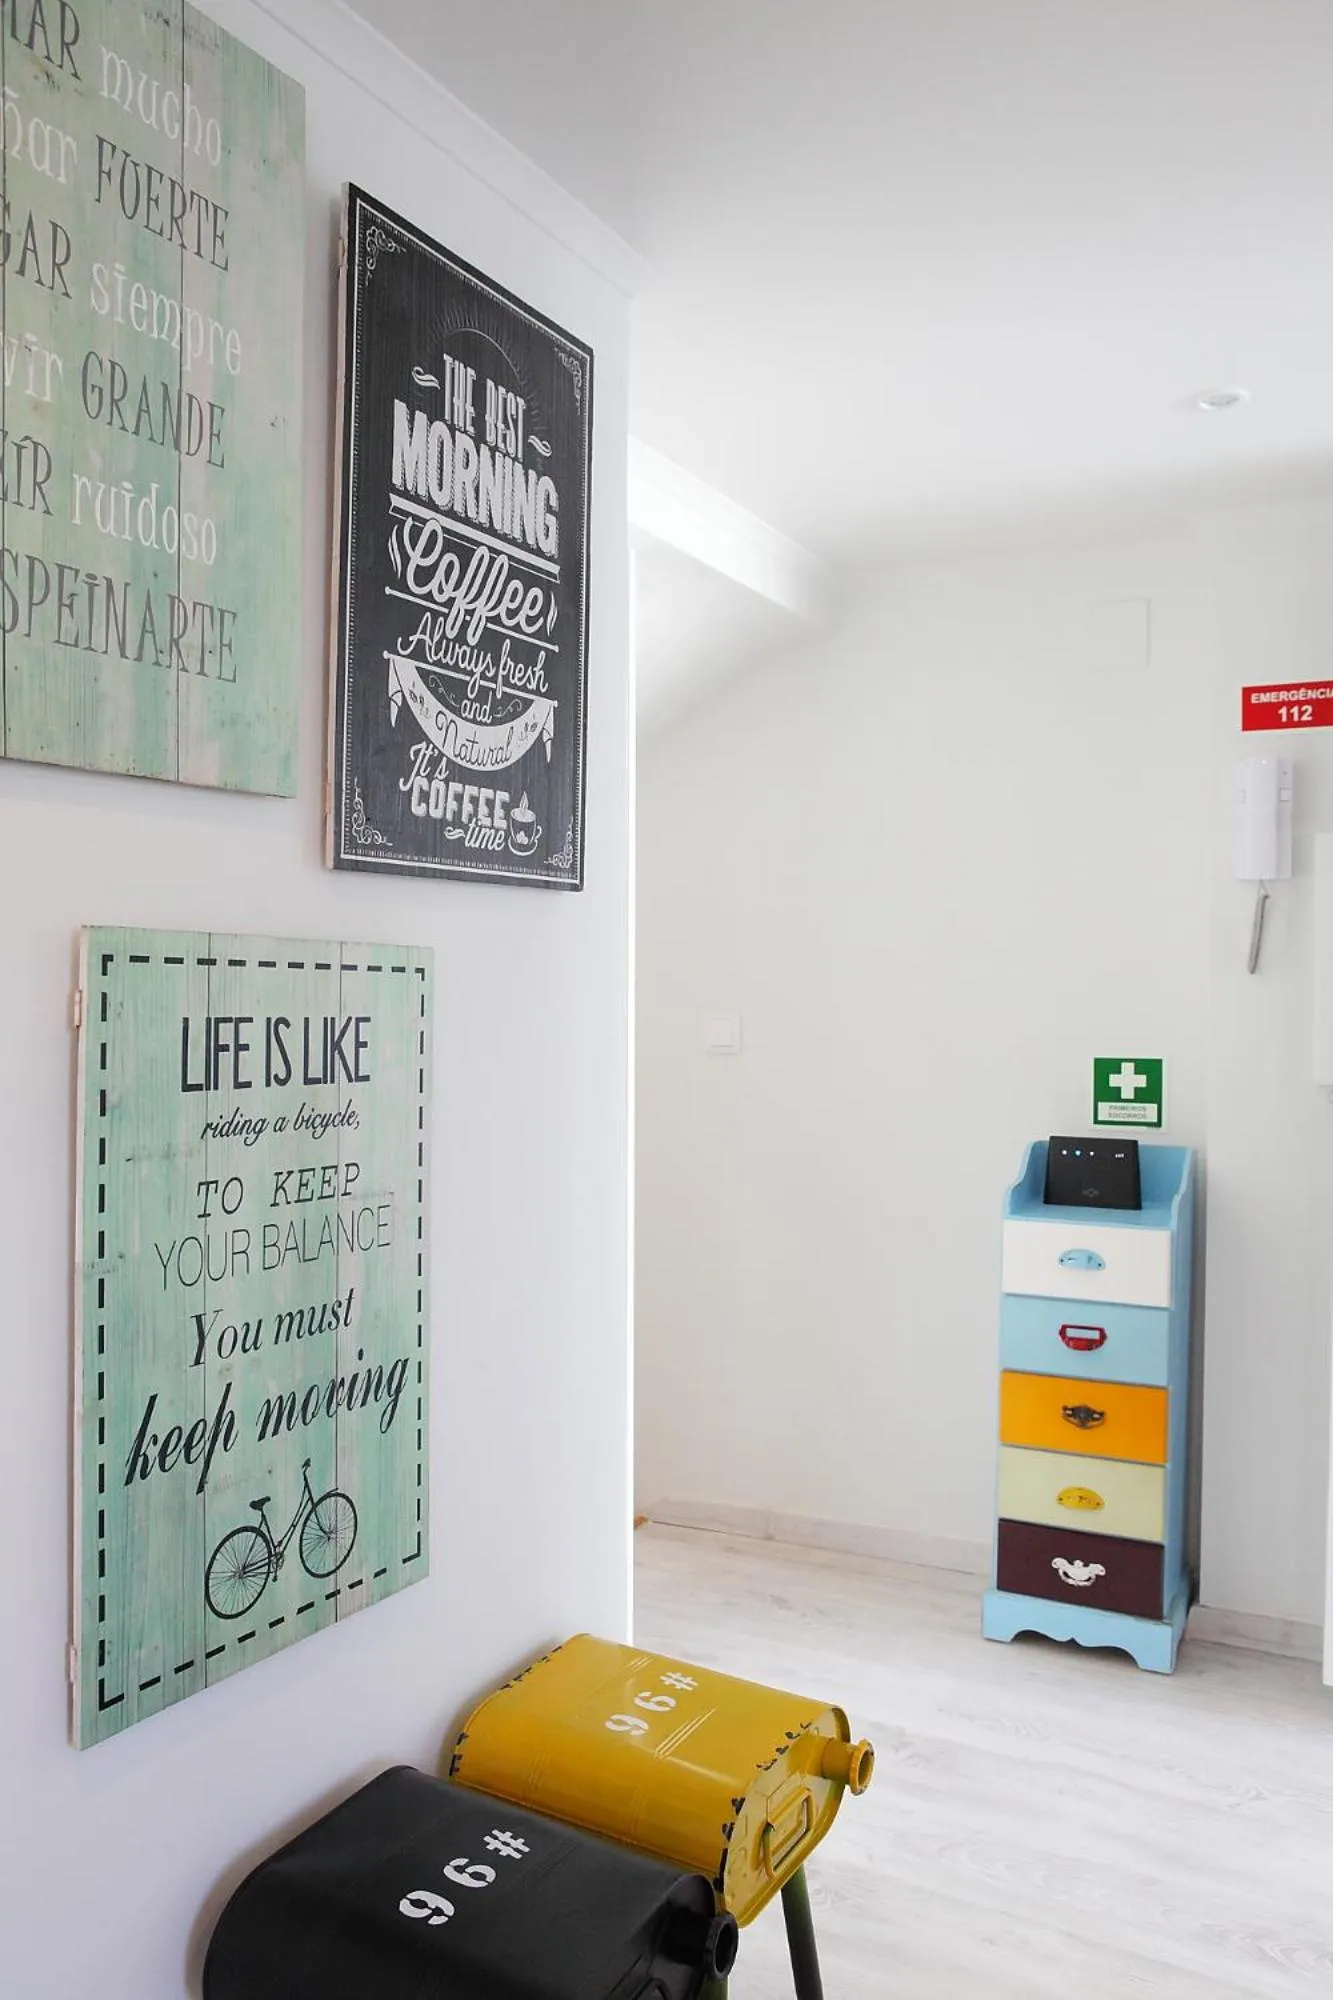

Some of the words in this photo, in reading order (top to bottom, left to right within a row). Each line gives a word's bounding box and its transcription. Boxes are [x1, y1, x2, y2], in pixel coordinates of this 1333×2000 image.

[11, 0, 82, 81] AR
[99, 46, 222, 167] mucho
[95, 134, 230, 272] FUERTE
[90, 262, 242, 375] siempre
[81, 351, 226, 469] GRANDE
[444, 353, 477, 437] THE
[484, 378, 527, 462] BEST
[72, 473, 217, 565] ruidoso
[392, 398, 560, 559] MORNING
[403, 516, 544, 645] Coffee
[397, 612, 496, 699] Always
[495, 638, 549, 699] fresh
[435, 710, 515, 767] Natural
[460, 691, 494, 724] and
[1277, 705, 1314, 722] 112
[399, 740, 449, 792] It's
[411, 775, 511, 830] COFFEE
[463, 819, 506, 852] time
[181, 1017, 254, 1093] LIFE
[264, 1017, 293, 1088] IS
[303, 1016, 372, 1086] LIKE
[200, 1106, 270, 1146] riding
[272, 1116, 291, 1132] a
[293, 1098, 361, 1140] bicycle,
[196, 1176, 245, 1219] TO
[269, 1162, 361, 1207] KEEP
[154, 1228, 251, 1291] YOUR
[262, 1204, 391, 1270] BALANCE
[189, 1308, 263, 1368] You
[273, 1287, 356, 1345] must
[123, 1382, 240, 1496] keep
[256, 1347, 410, 1442] moving
